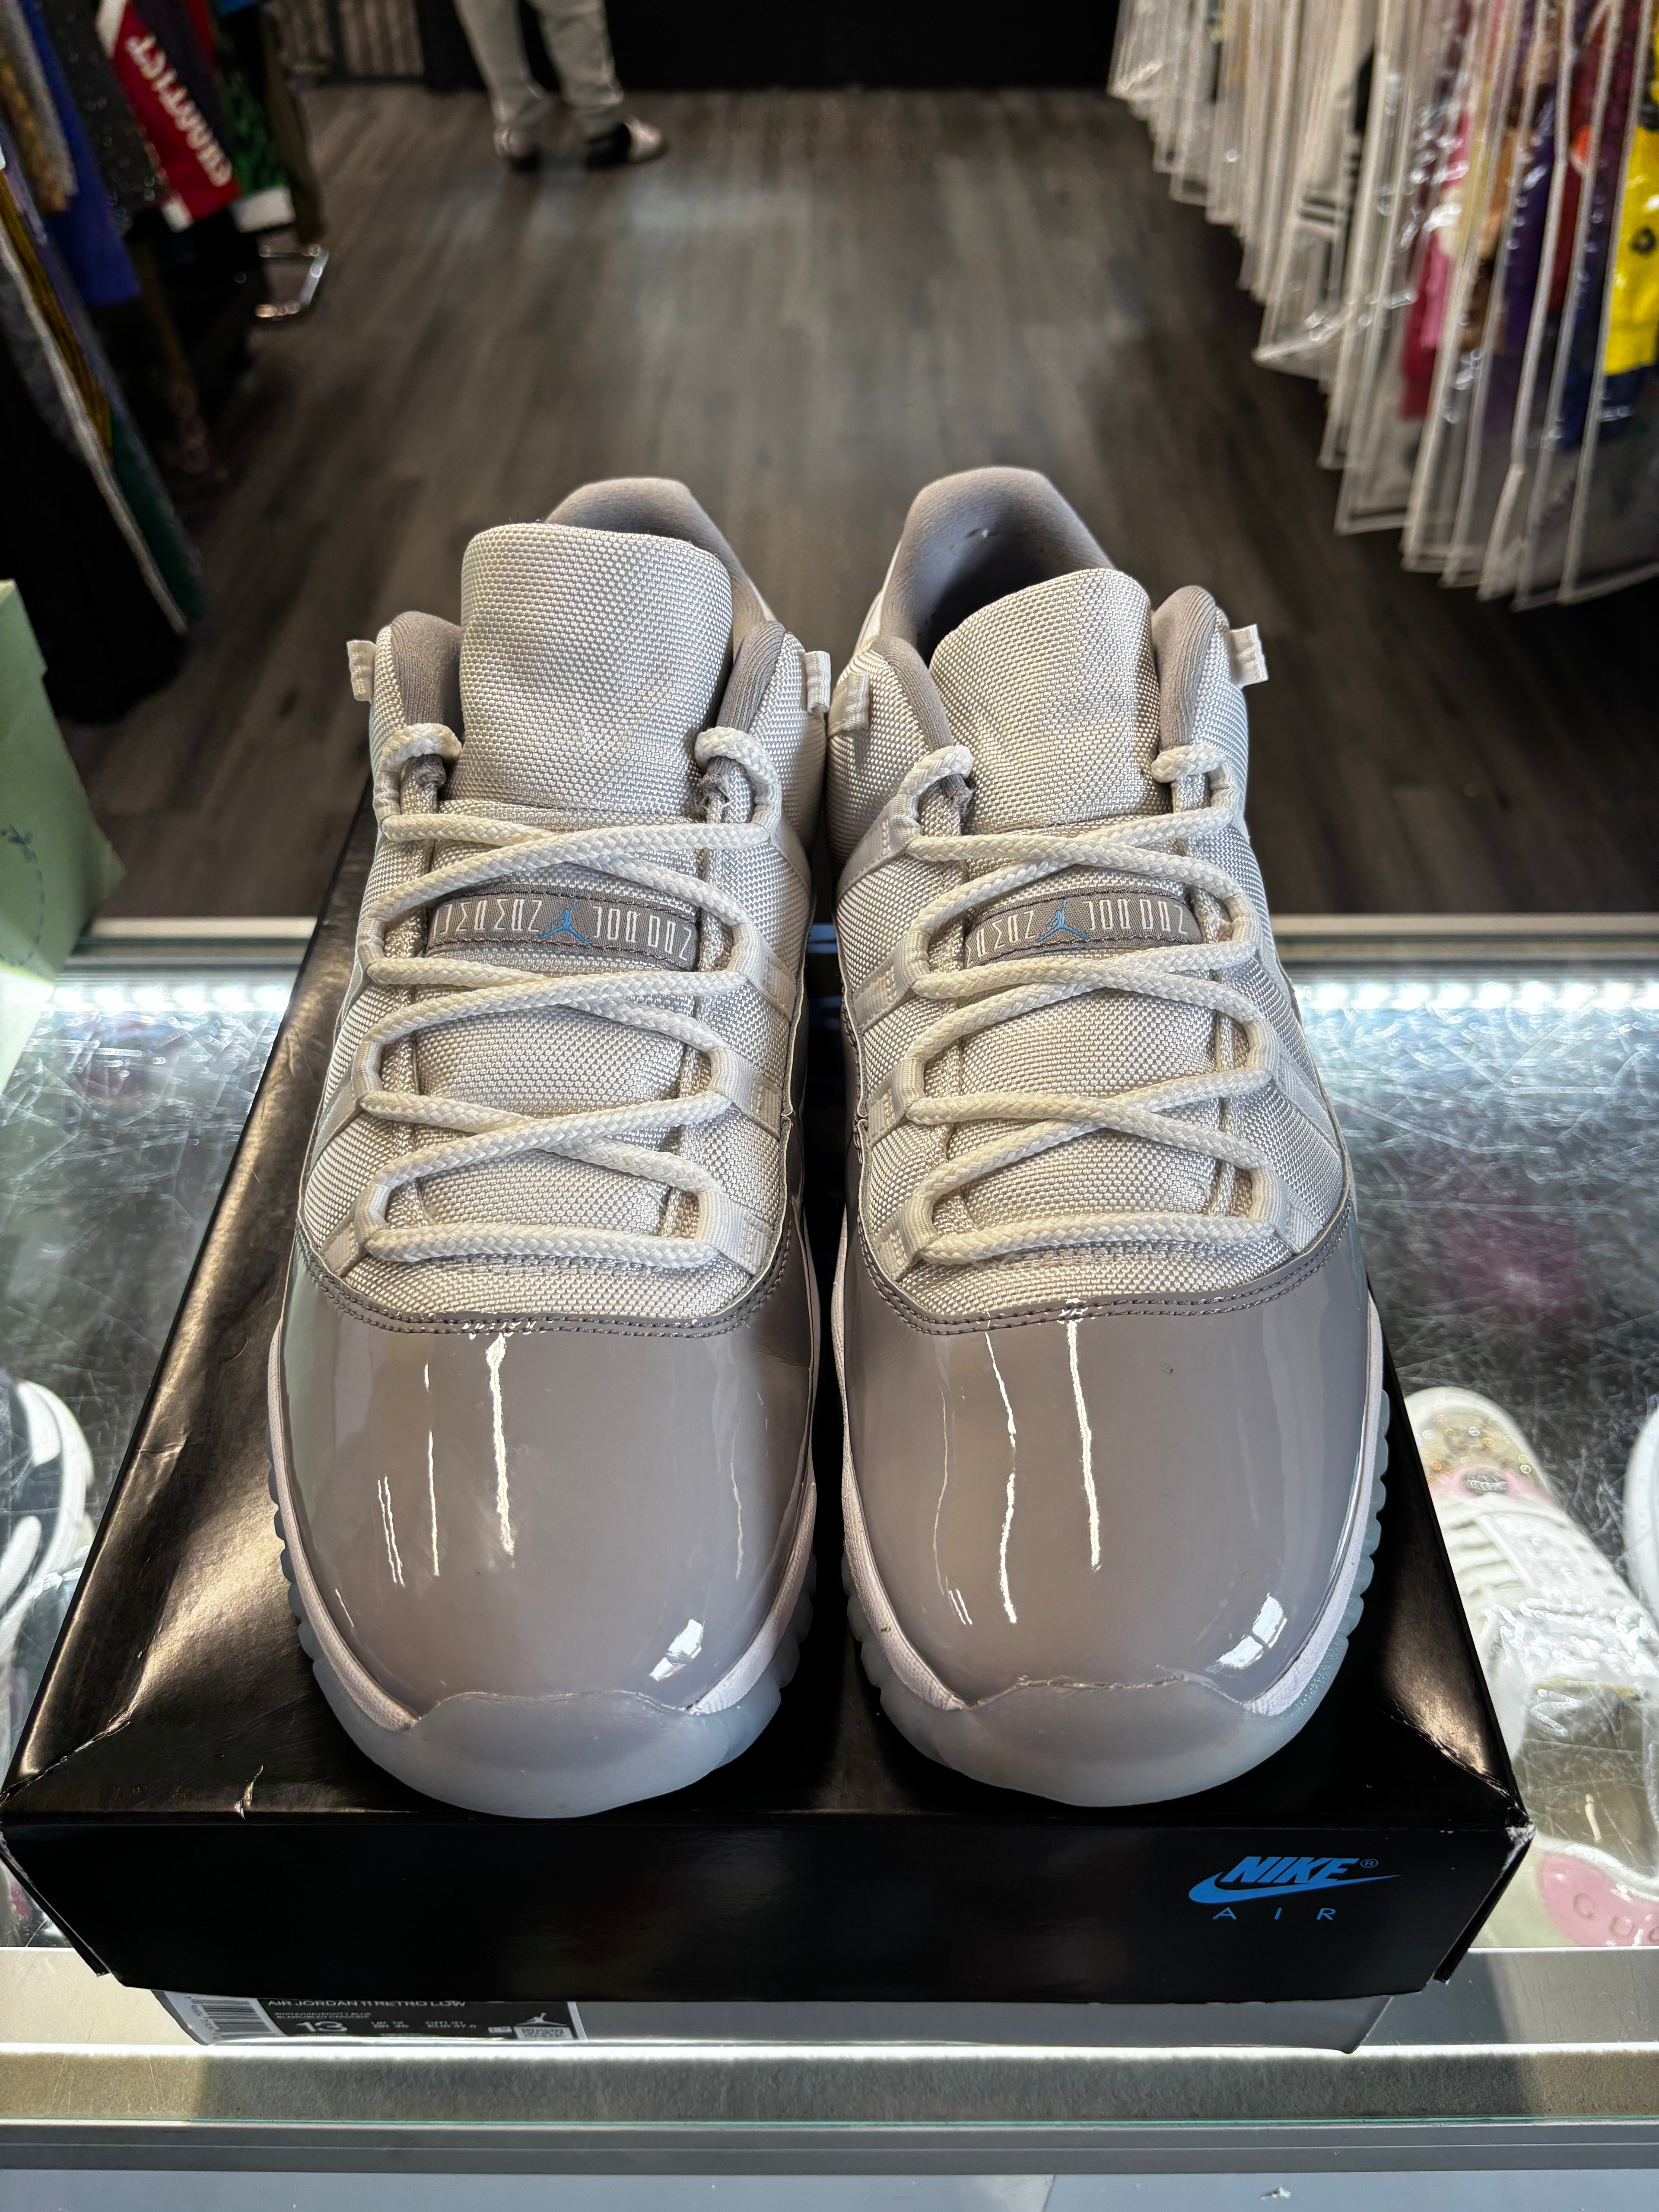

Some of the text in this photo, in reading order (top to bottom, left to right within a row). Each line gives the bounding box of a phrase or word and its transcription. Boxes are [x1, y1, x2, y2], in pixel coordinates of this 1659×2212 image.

[1220, 1856, 1360, 1883] NIKE
[1212, 1906, 1336, 1920] AIR
[296, 2021, 348, 2032] 13
